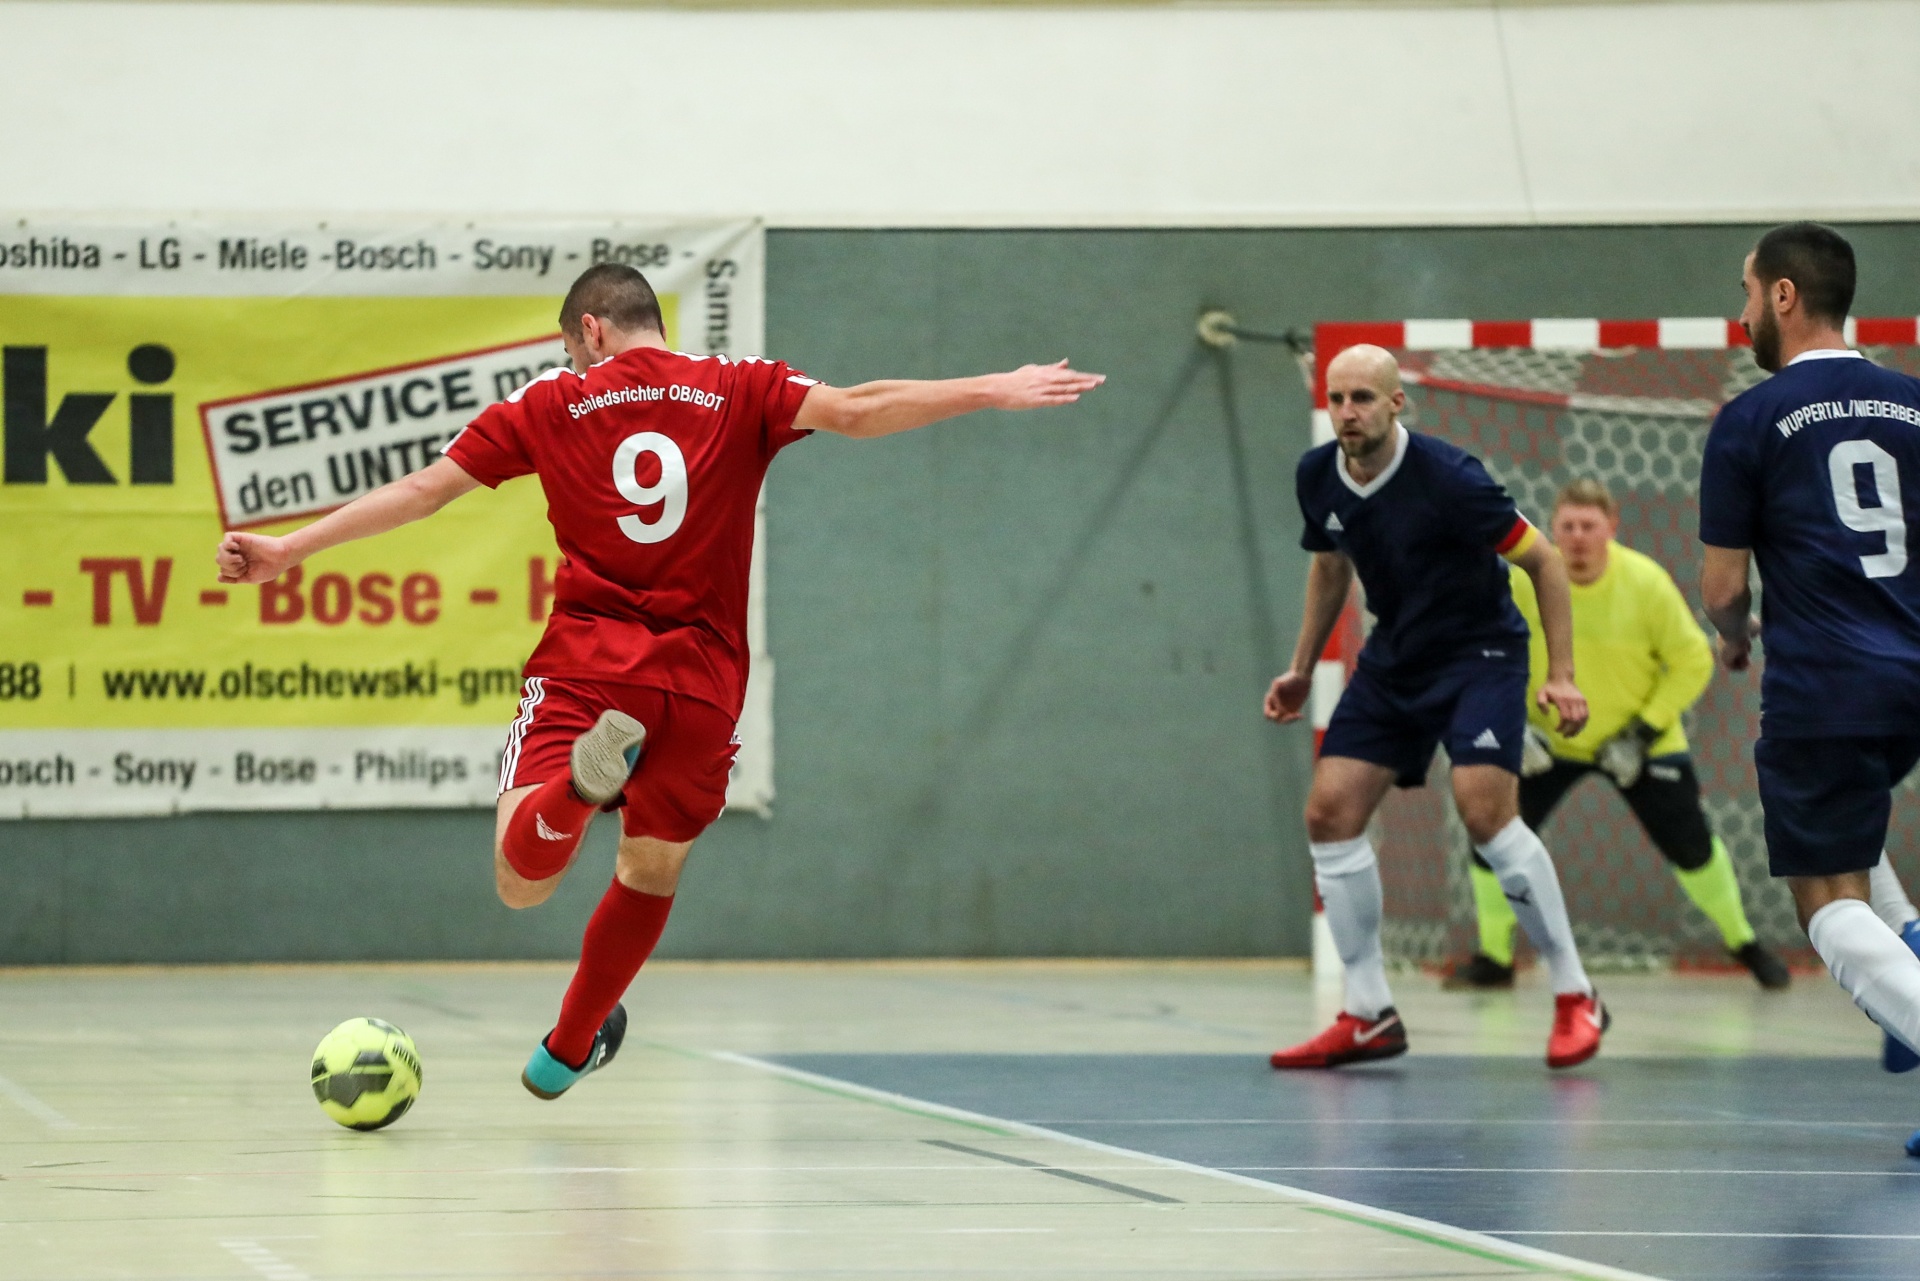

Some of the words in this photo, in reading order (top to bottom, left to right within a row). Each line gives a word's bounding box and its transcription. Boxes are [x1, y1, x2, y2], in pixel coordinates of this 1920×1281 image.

[139, 239, 181, 270] LG
[218, 238, 307, 270] Miele
[474, 239, 554, 276] Sony
[591, 238, 669, 267] Bose
[2, 343, 176, 486] ki
[223, 369, 479, 455] SERVICE
[568, 385, 666, 420] Schiedsrichter
[668, 384, 725, 411] OB/BOT
[238, 472, 316, 515] den
[327, 429, 461, 496] UNTE
[612, 431, 689, 543] 9
[1828, 439, 1908, 578] 9
[79, 557, 174, 626] TV
[259, 560, 442, 626] Bose
[0, 662, 42, 700] 88
[103, 660, 526, 706] www.olschewski-gm
[113, 751, 197, 791] Sony
[235, 751, 317, 784] Bose
[355, 749, 468, 788] Philips
